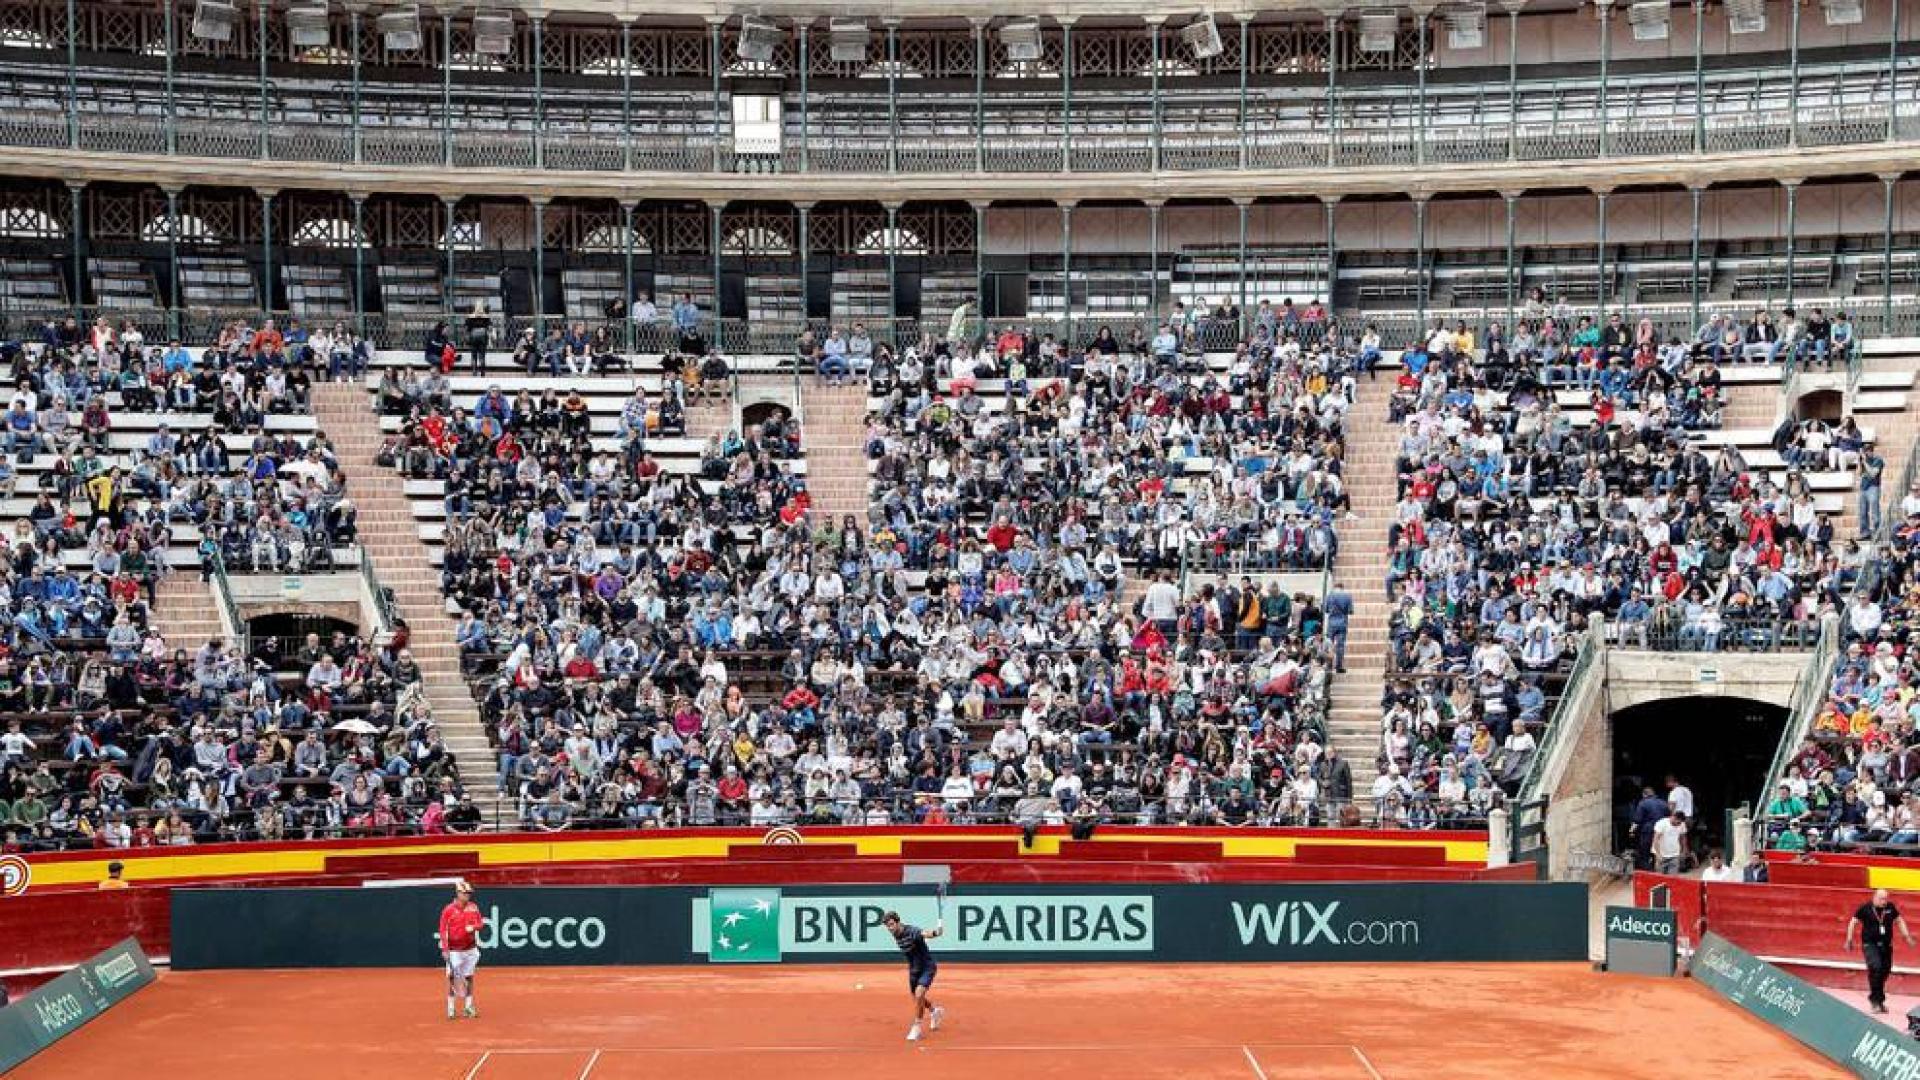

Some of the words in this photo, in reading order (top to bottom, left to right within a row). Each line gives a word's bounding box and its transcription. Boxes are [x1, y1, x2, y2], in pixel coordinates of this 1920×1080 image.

[434, 905, 607, 949] decco
[794, 905, 885, 944] BNP
[957, 903, 1148, 942] PARIBAS
[1609, 914, 1672, 936] Adecco
